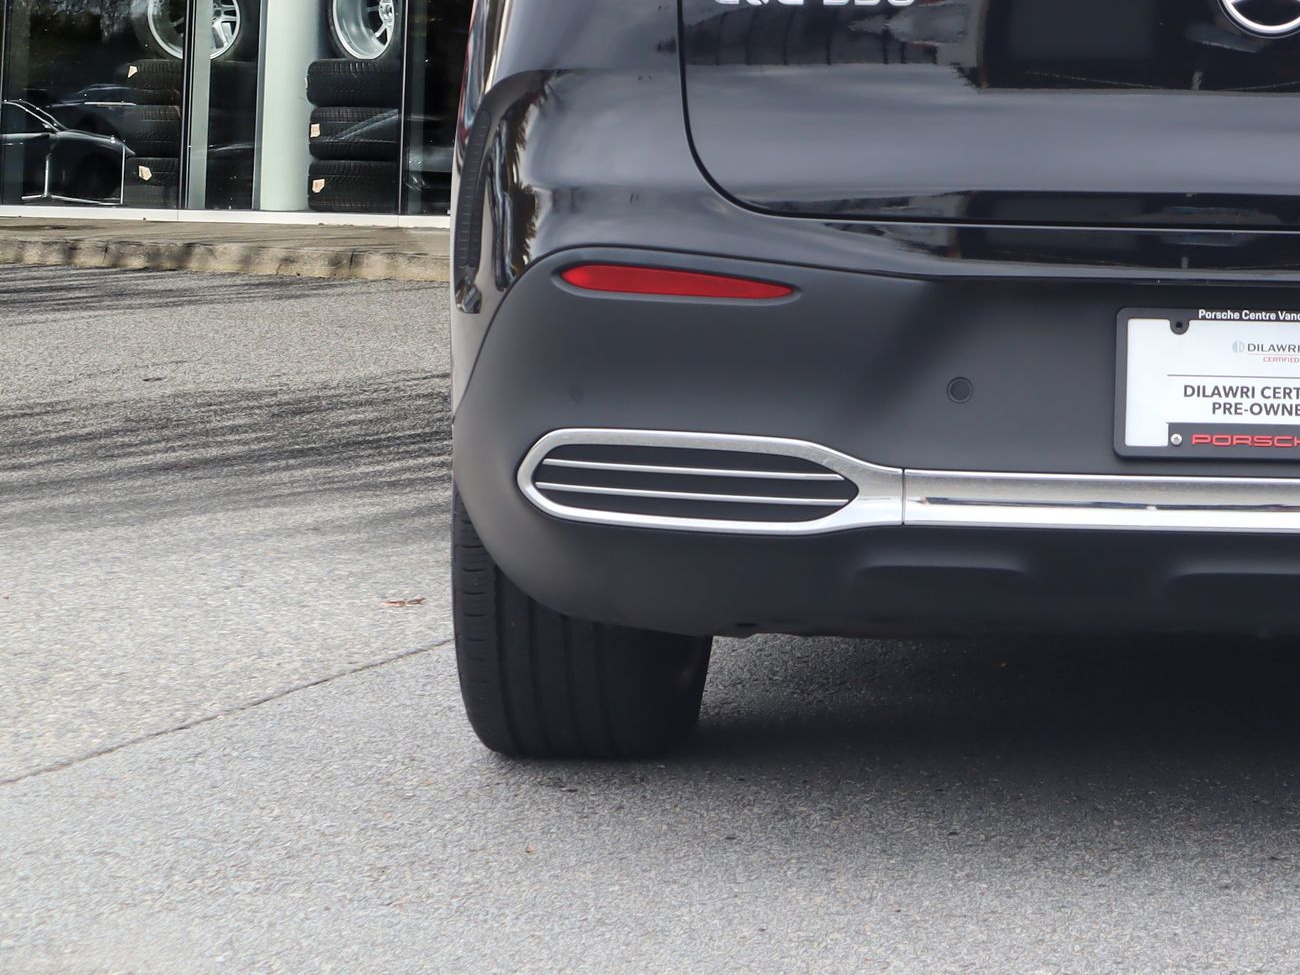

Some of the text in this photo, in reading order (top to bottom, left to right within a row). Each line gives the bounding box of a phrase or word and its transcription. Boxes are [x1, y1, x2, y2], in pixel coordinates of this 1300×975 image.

[1198, 309, 1240, 320] Porsche
[1241, 310, 1277, 321] Centre
[1247, 343, 1300, 353] DILAWRI
[1262, 356, 1300, 364] CERTIFIED
[1183, 385, 1256, 399] DILAWRI
